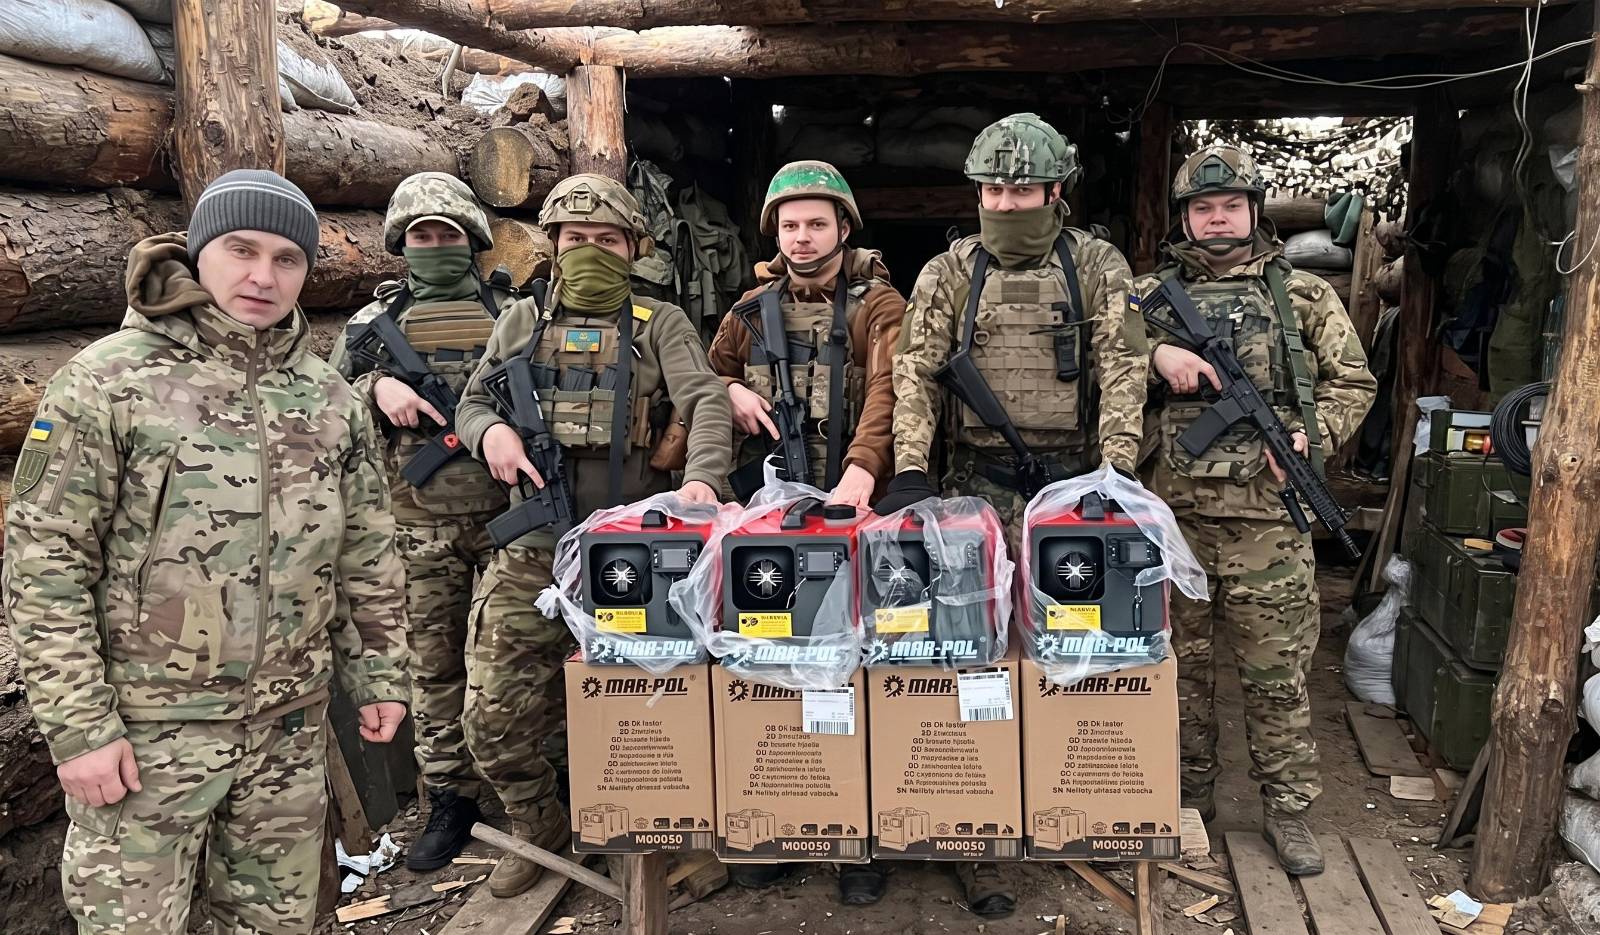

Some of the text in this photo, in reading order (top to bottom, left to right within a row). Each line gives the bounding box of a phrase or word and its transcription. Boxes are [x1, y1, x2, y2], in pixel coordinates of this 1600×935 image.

[614, 640, 697, 656] MAR-POL
[890, 640, 978, 656] MAR-POL
[1062, 636, 1150, 653] MAR-POL
[755, 646, 840, 661] MAR-POL
[605, 677, 688, 694] MAR-POL
[742, 789, 753, 797] SN
[896, 786, 908, 794] SN
[1052, 786, 1064, 794] SN
[635, 834, 683, 844] M00050
[782, 841, 831, 851] M00050
[936, 841, 986, 851] M00050
[1092, 840, 1143, 850] M00050
